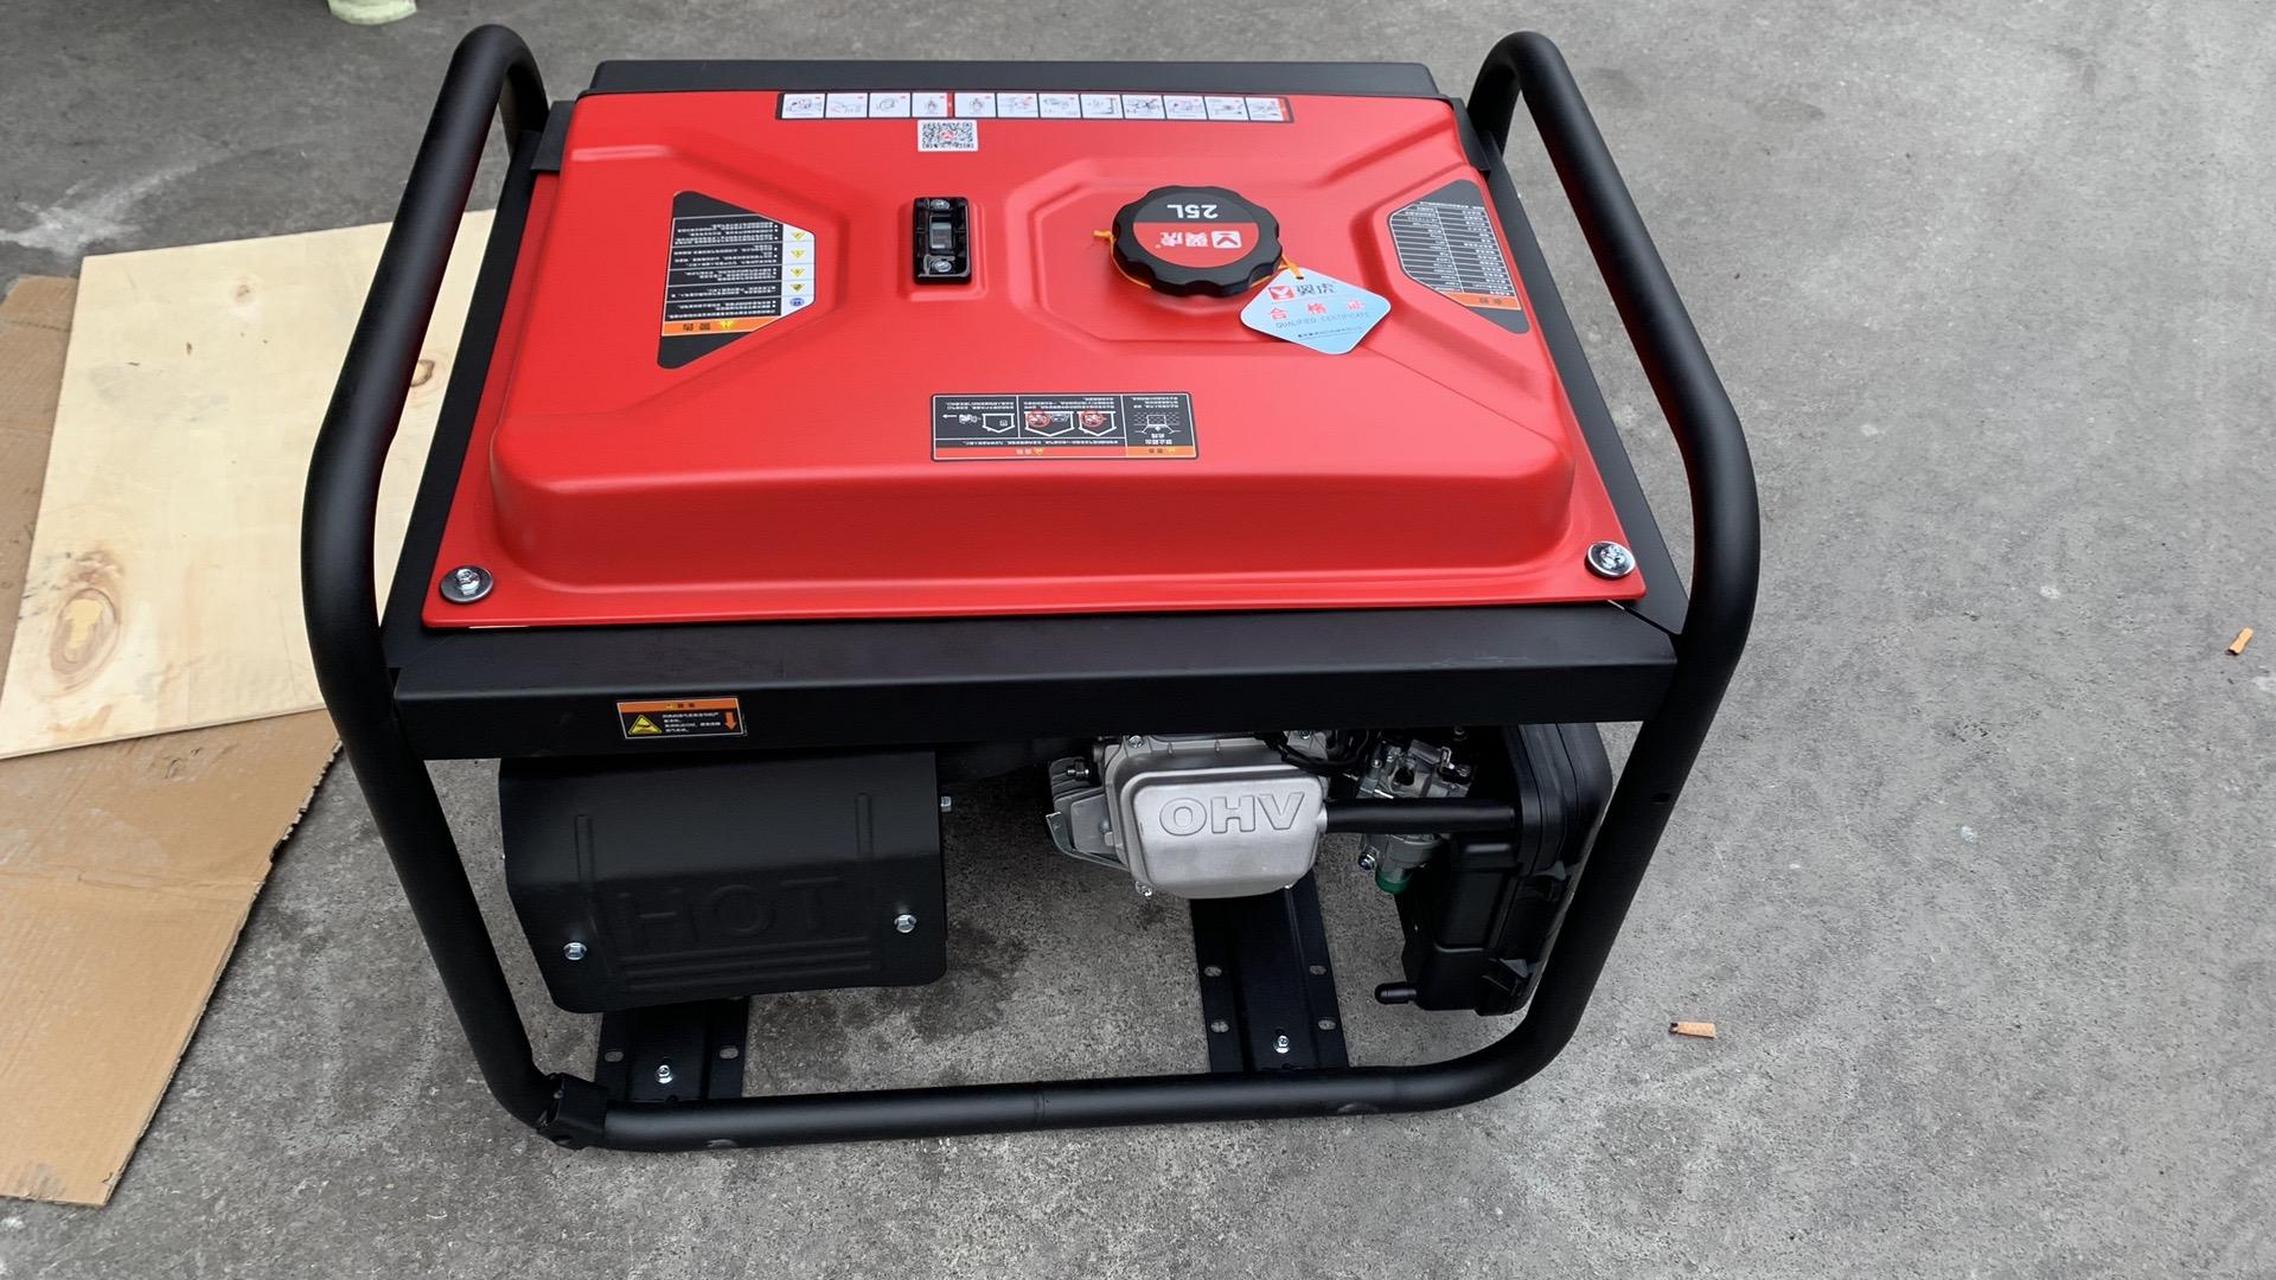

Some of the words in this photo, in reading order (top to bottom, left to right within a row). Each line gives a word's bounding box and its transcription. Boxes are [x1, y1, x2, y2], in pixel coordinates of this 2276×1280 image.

[1166, 204, 1219, 219] 25L
[1159, 791, 1305, 836] OHV
[616, 876, 840, 944] HOT
